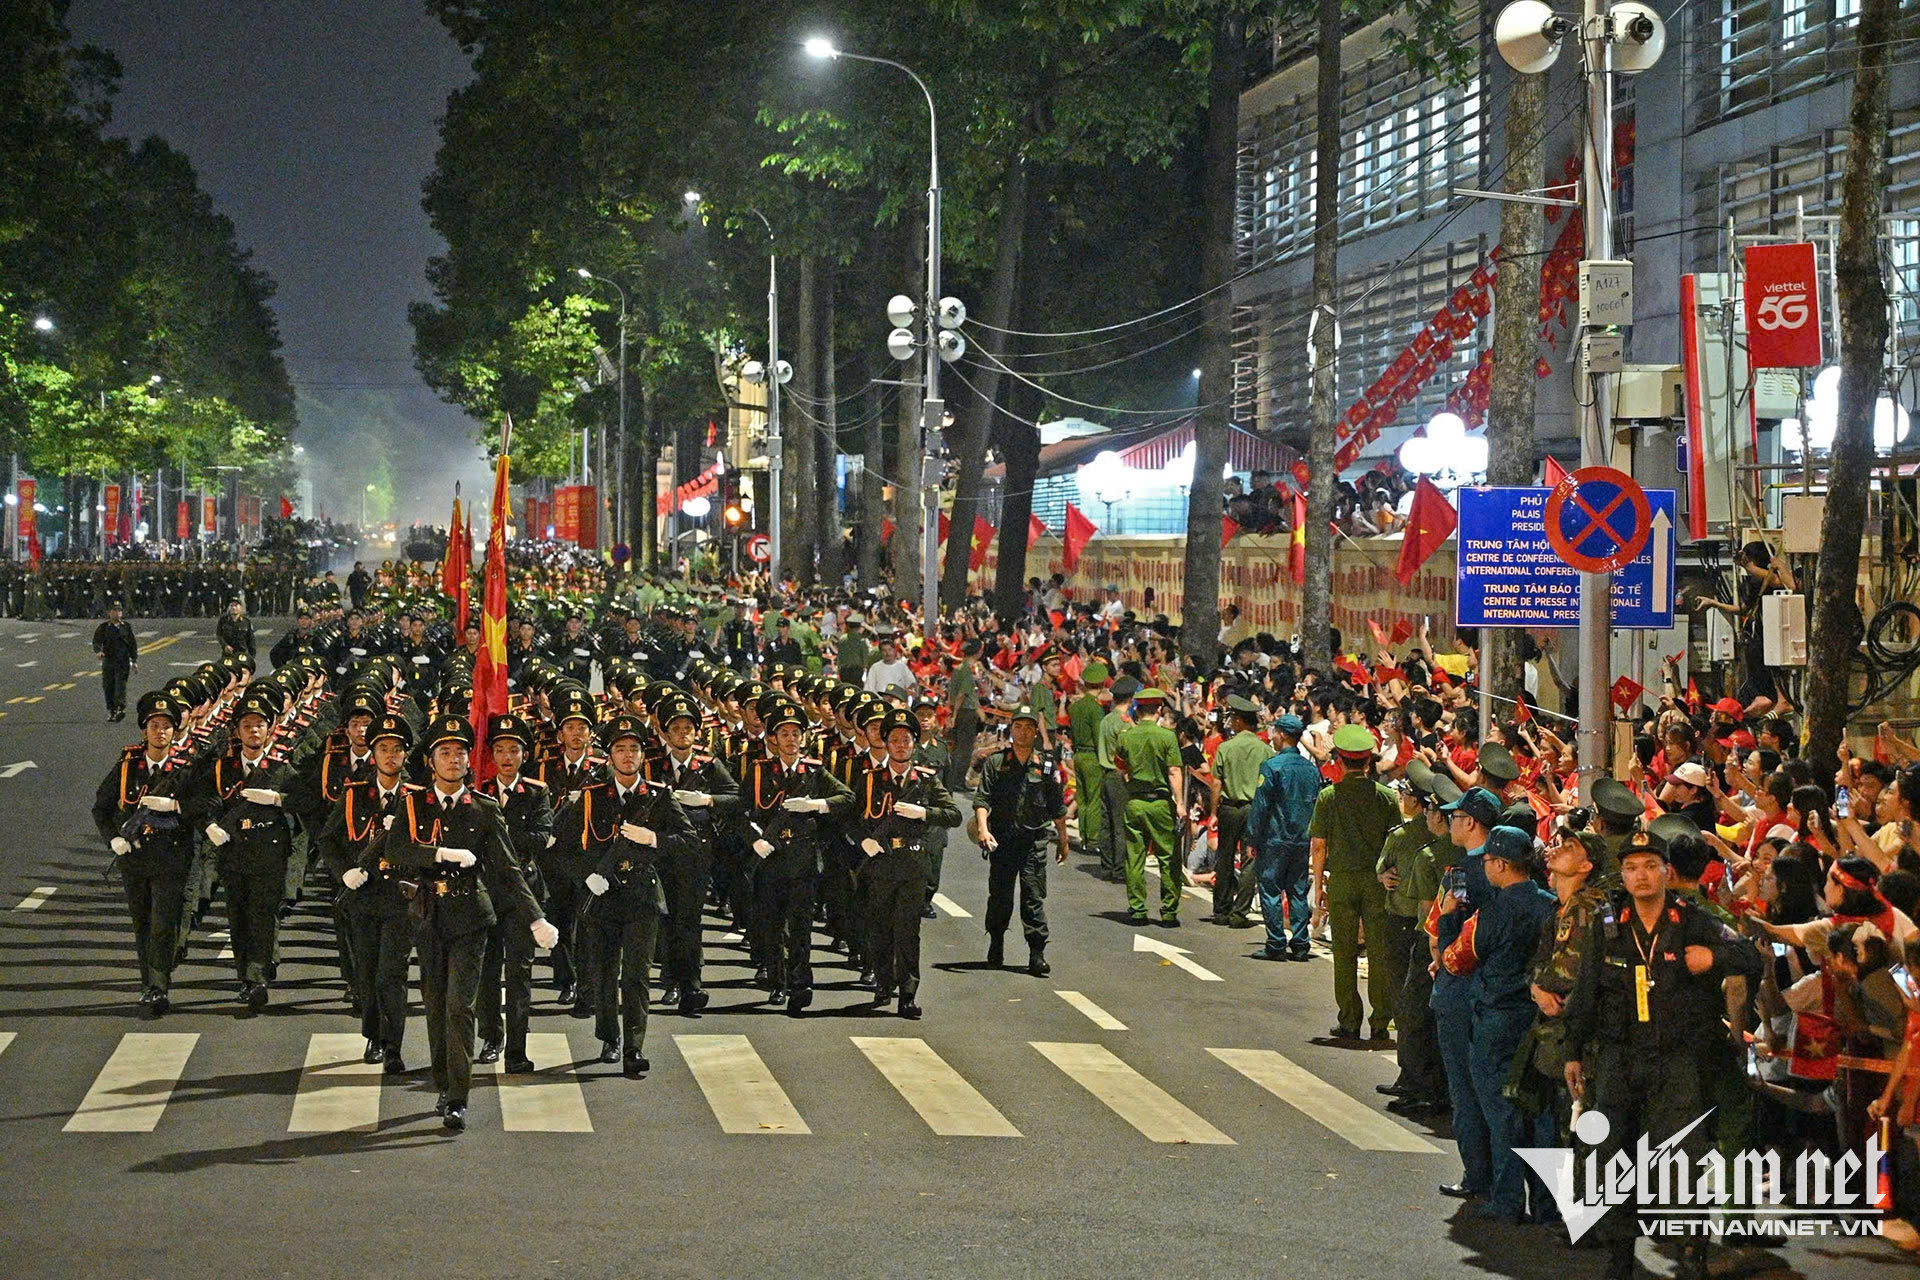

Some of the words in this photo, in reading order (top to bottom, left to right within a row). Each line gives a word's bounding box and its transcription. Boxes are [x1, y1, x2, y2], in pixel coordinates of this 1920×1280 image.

[1764, 281, 1807, 293] viettel
[1757, 294, 1809, 331] 5G
[1512, 509, 1541, 519] PALAIS
[1466, 540, 1503, 550] TRUNG
[1507, 538, 1529, 550] TÂM
[1466, 553, 1500, 563] CENTRE
[1502, 553, 1514, 563] DE
[1466, 565, 1532, 576] INTERNATIONAL
[1534, 566, 1580, 576] CONFEREN
[1483, 584, 1520, 594] TRUNG
[1523, 582, 1547, 594] TÂM
[1549, 582, 1572, 594] BÁO
[1628, 582, 1643, 595] TẾ
[1483, 597, 1518, 606] CENTRE
[1520, 597, 1532, 606] DE
[1534, 597, 1567, 607] PRESSE
[1483, 609, 1550, 619] INTERNATIONAL
